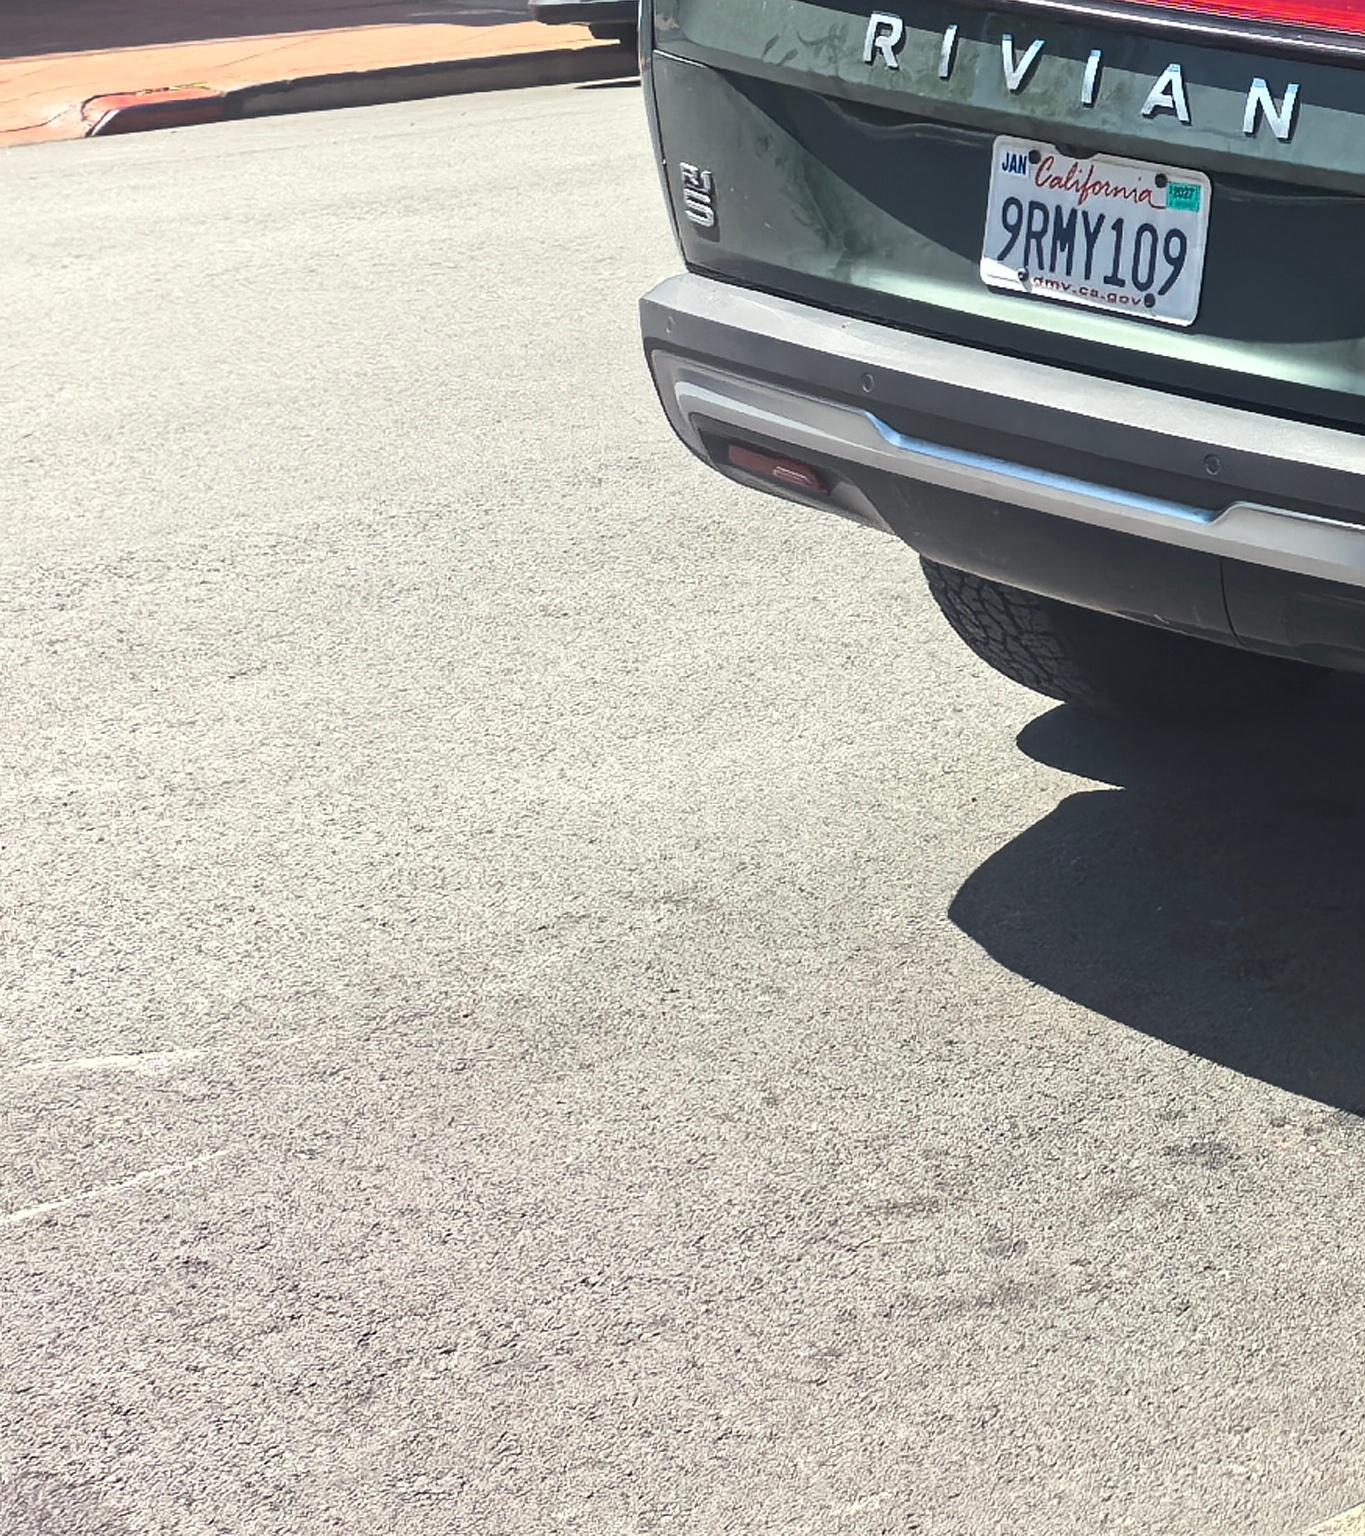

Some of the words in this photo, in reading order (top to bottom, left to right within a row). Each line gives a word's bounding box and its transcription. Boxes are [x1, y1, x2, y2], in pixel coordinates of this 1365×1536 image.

[863, 11, 1299, 140] RIVIAN
[1001, 151, 1027, 175] JAN
[1034, 155, 1167, 209] California
[997, 196, 1188, 296] 9RMY109
[1032, 276, 1142, 306] dmv.ca.gov
